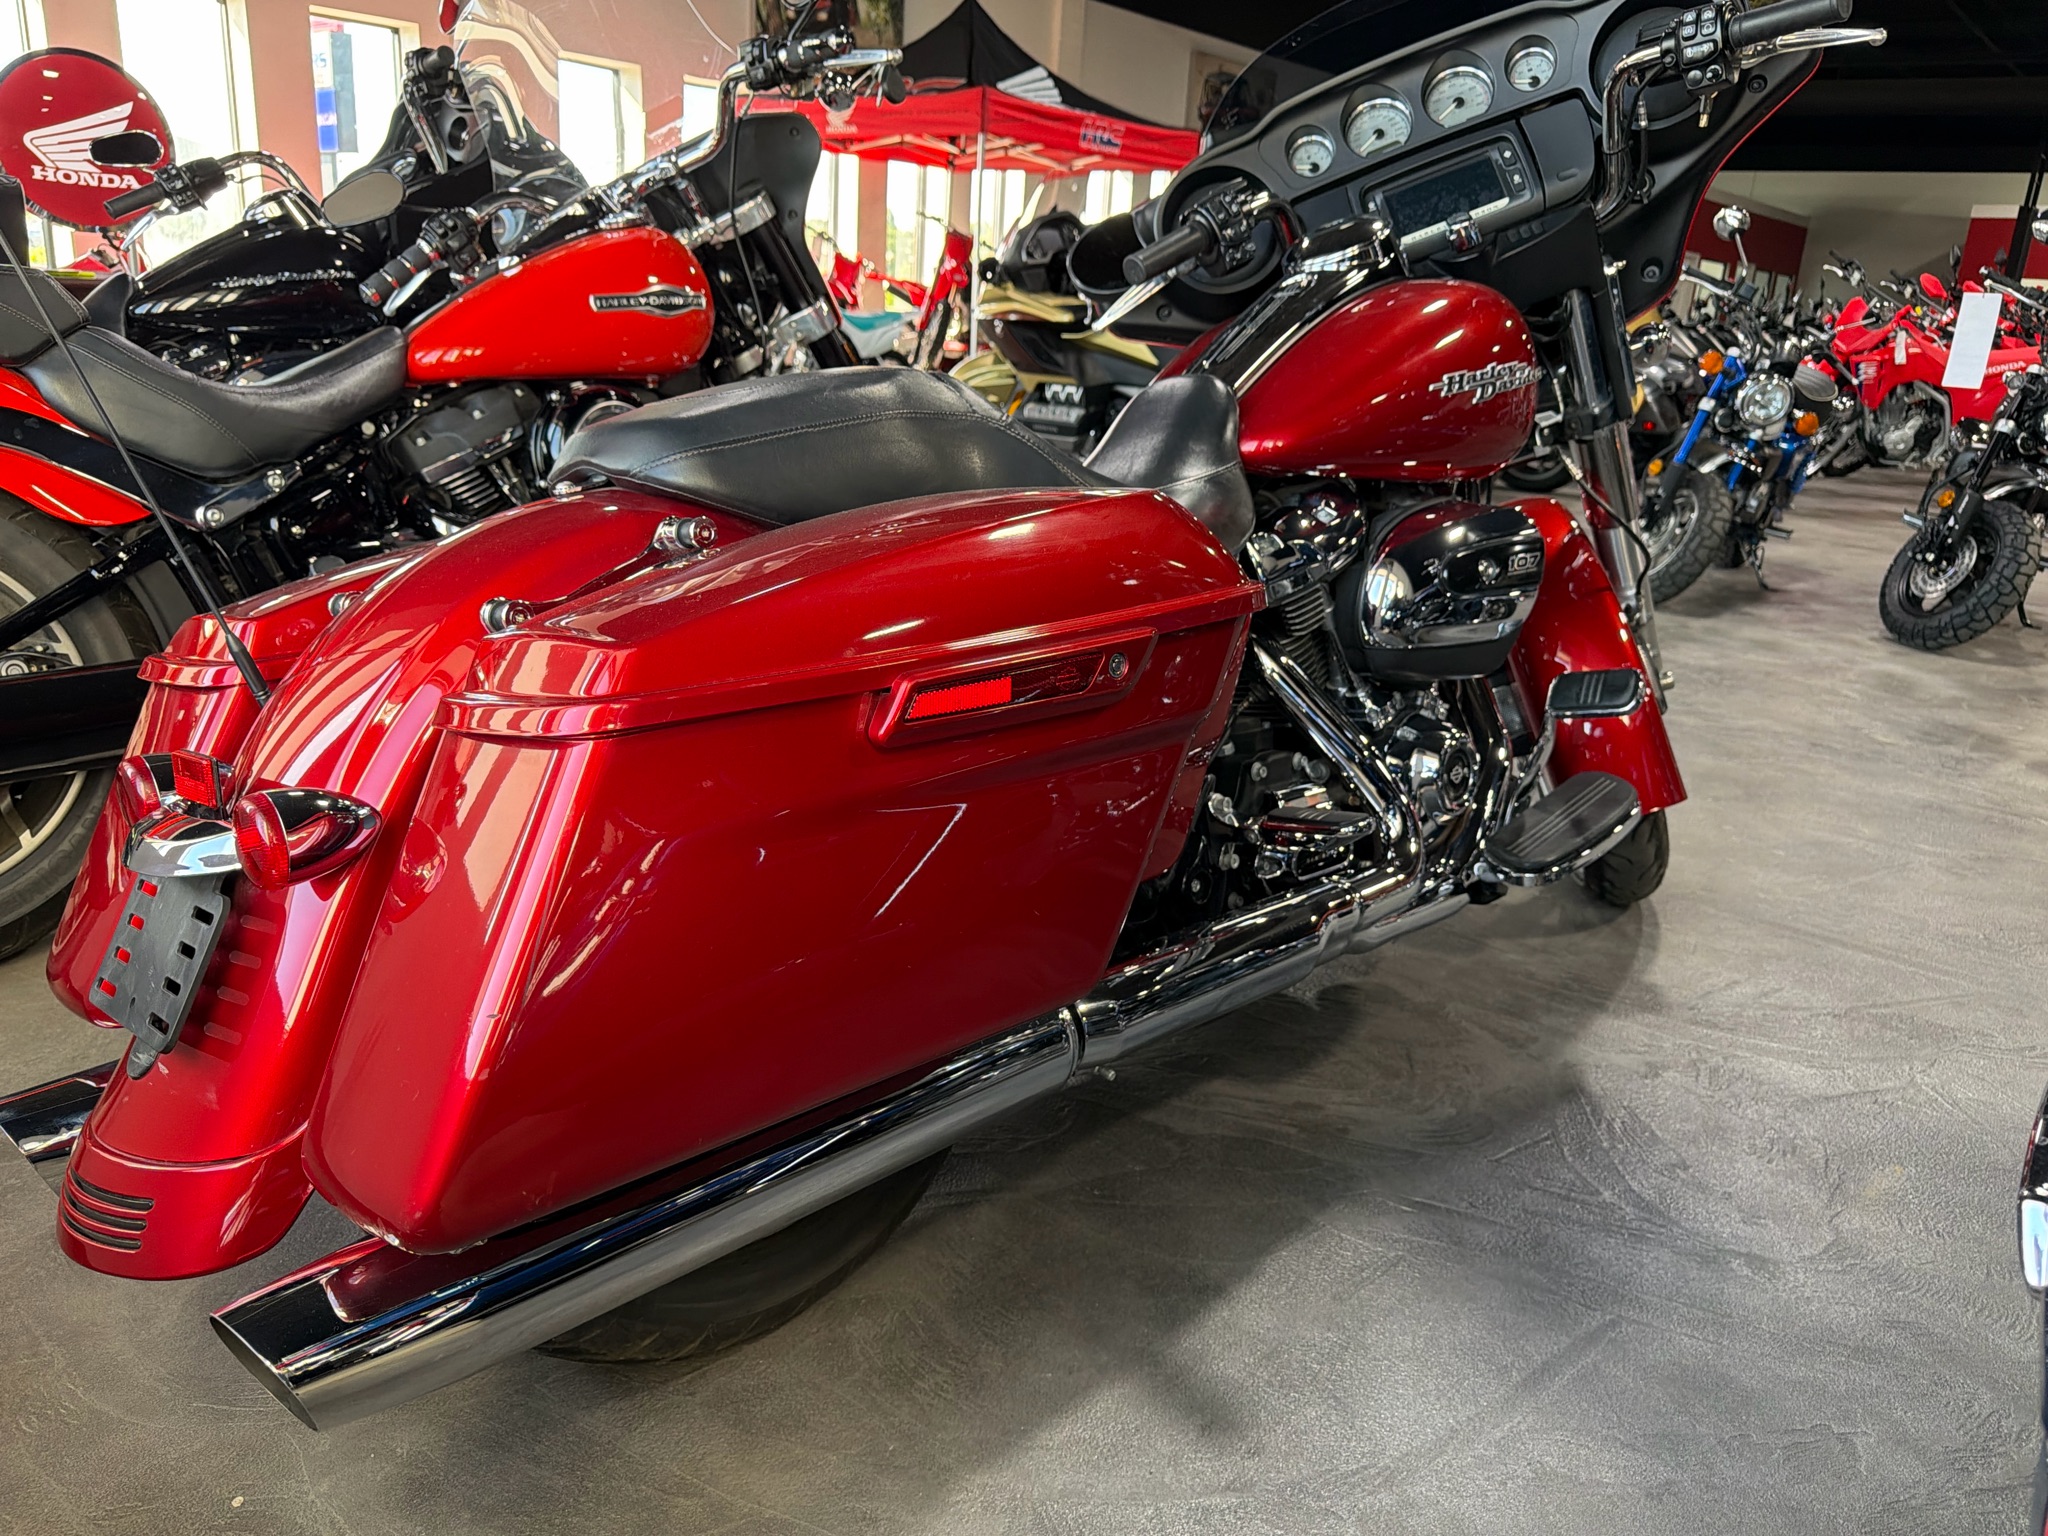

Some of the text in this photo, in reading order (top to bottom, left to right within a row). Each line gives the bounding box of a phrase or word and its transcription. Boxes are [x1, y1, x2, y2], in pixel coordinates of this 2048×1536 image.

[31, 165, 142, 190] HONDA
[1429, 361, 1528, 397] Harley
[1985, 360, 2027, 375] HONDA
[1508, 551, 1541, 572] 107
